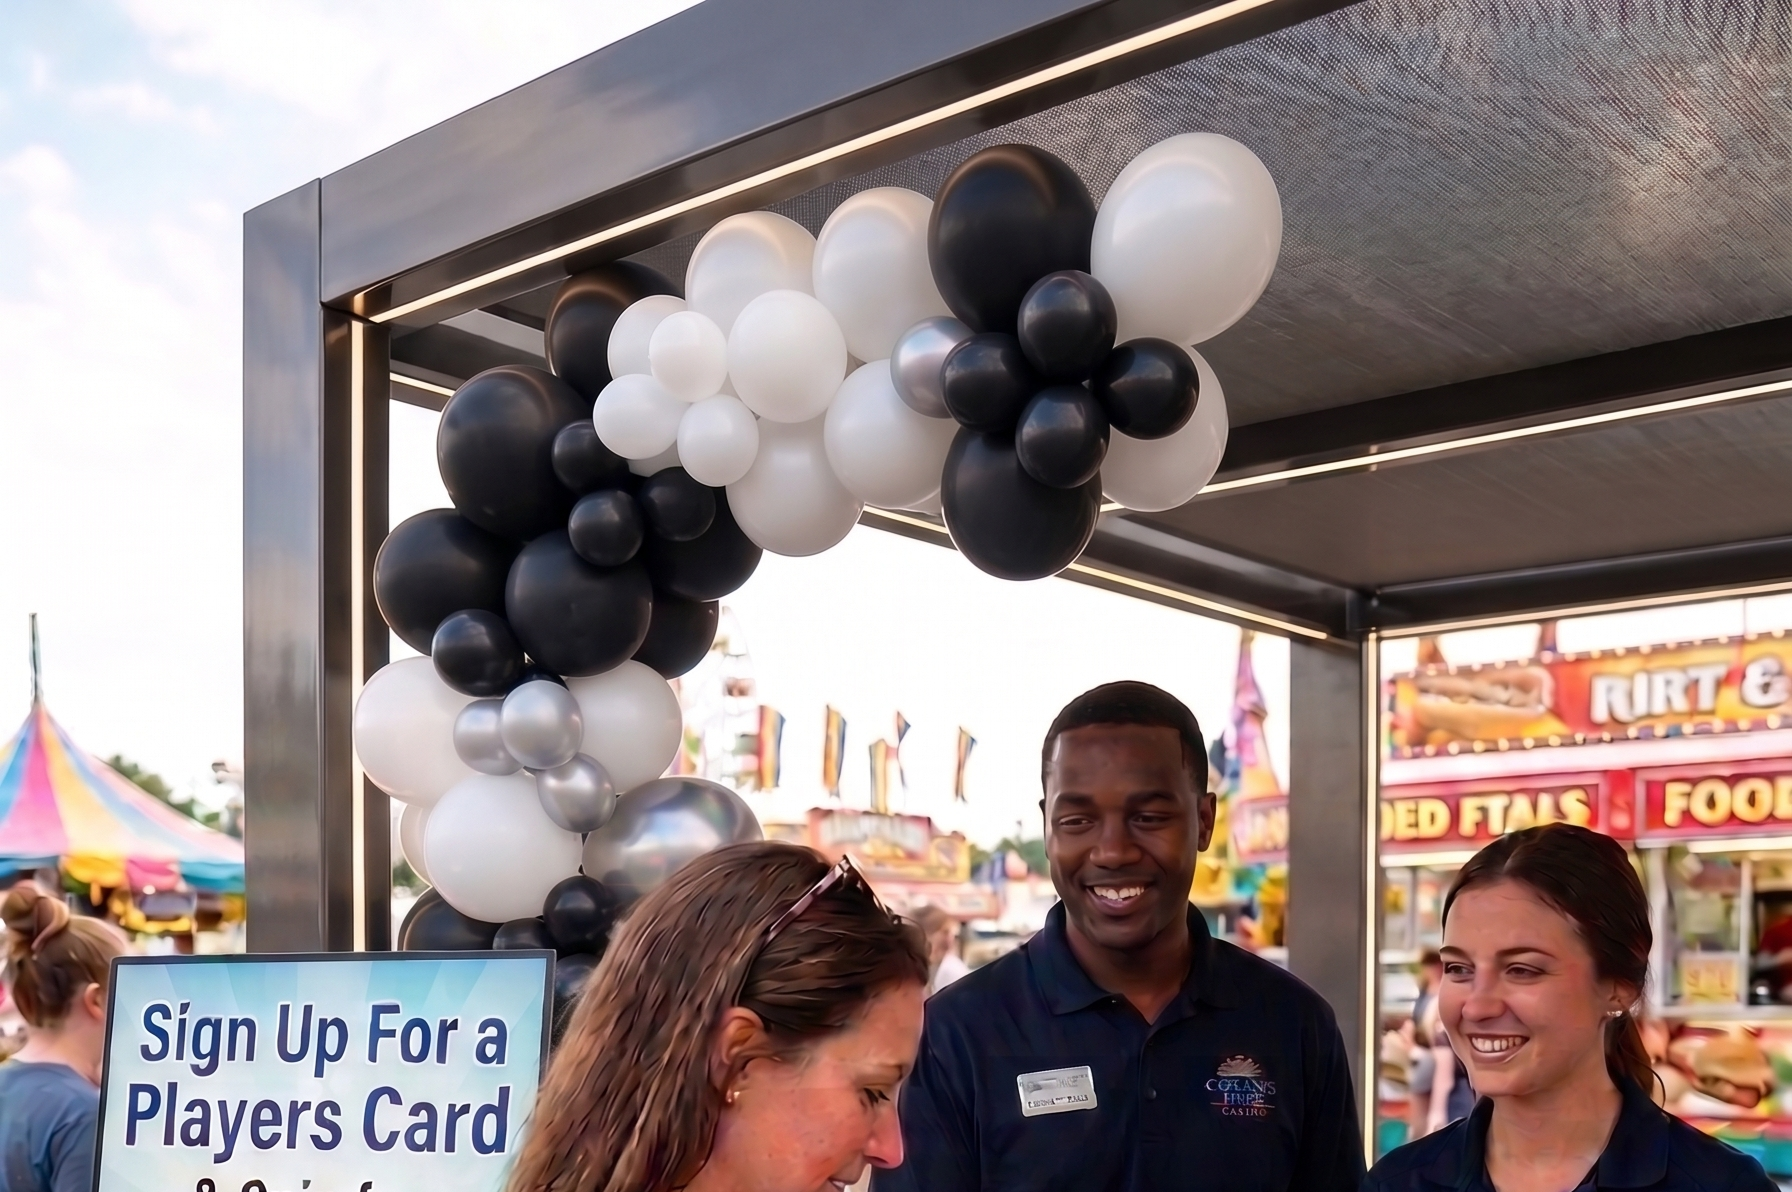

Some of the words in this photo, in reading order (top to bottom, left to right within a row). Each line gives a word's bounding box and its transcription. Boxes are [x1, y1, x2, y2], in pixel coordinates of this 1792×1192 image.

[140, 1000, 256, 1076] Sign
[276, 1003, 348, 1078] Up
[367, 1004, 458, 1065] For
[475, 1018, 508, 1067] a
[126, 1082, 341, 1163] Players
[362, 1086, 510, 1154] Card
